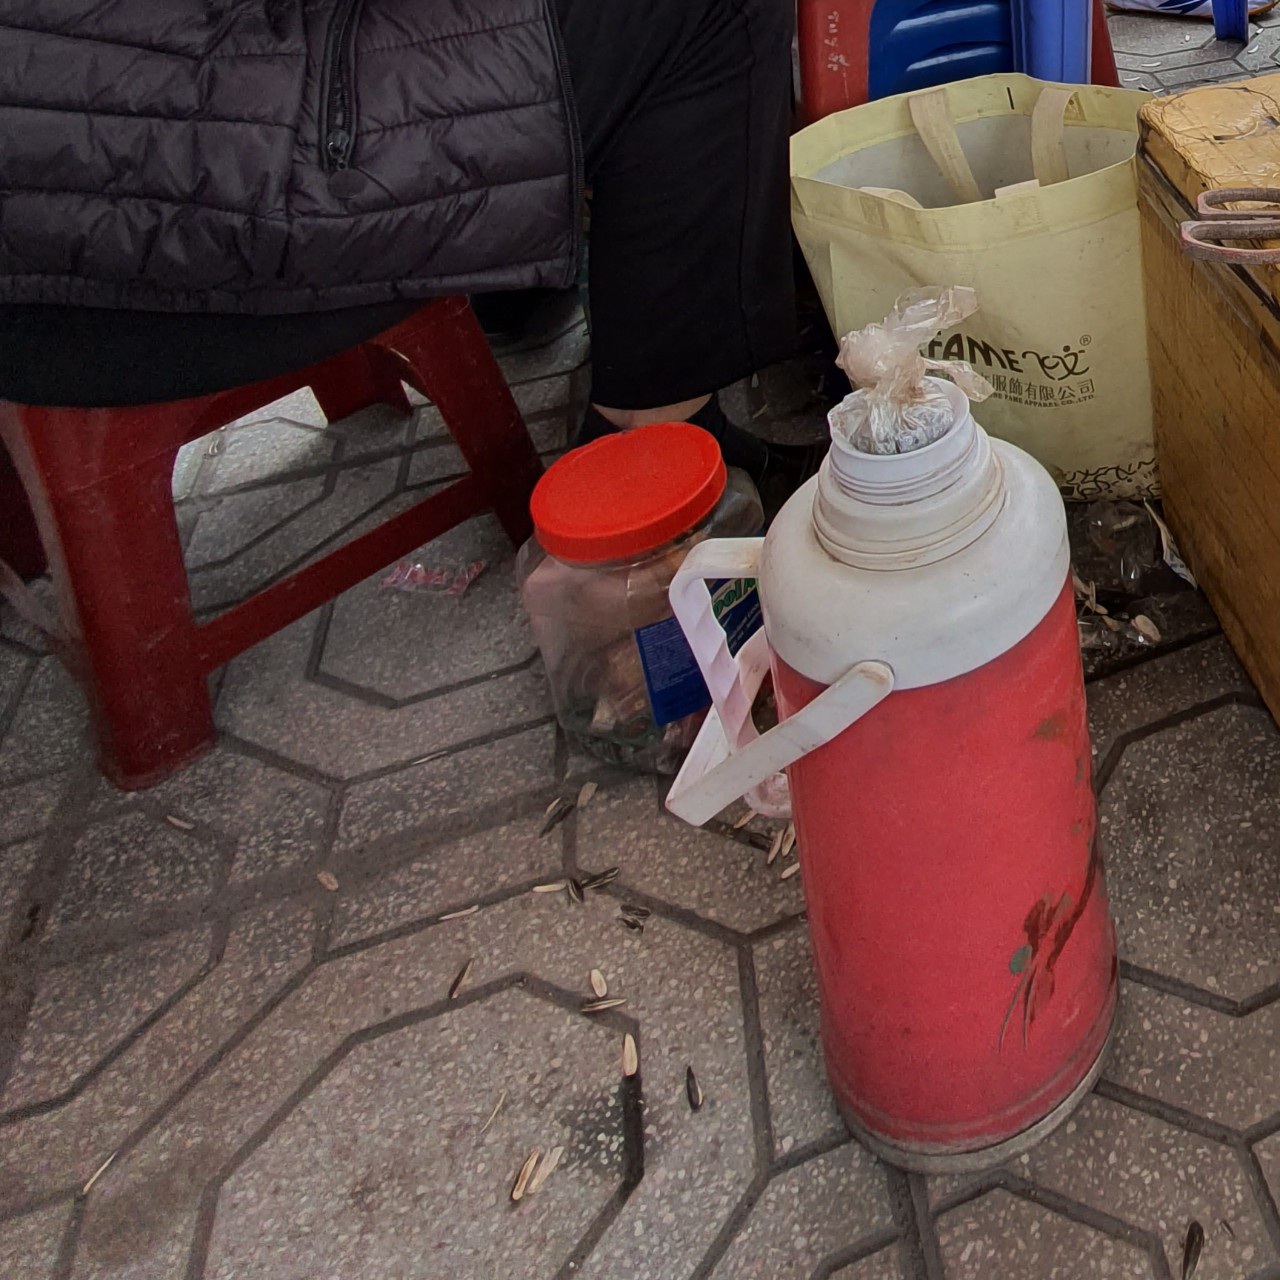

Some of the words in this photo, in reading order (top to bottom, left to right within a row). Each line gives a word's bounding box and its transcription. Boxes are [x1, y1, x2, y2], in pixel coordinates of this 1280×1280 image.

[919, 330, 1024, 373] FAME
[981, 372, 1096, 402] 服飾有限公司
